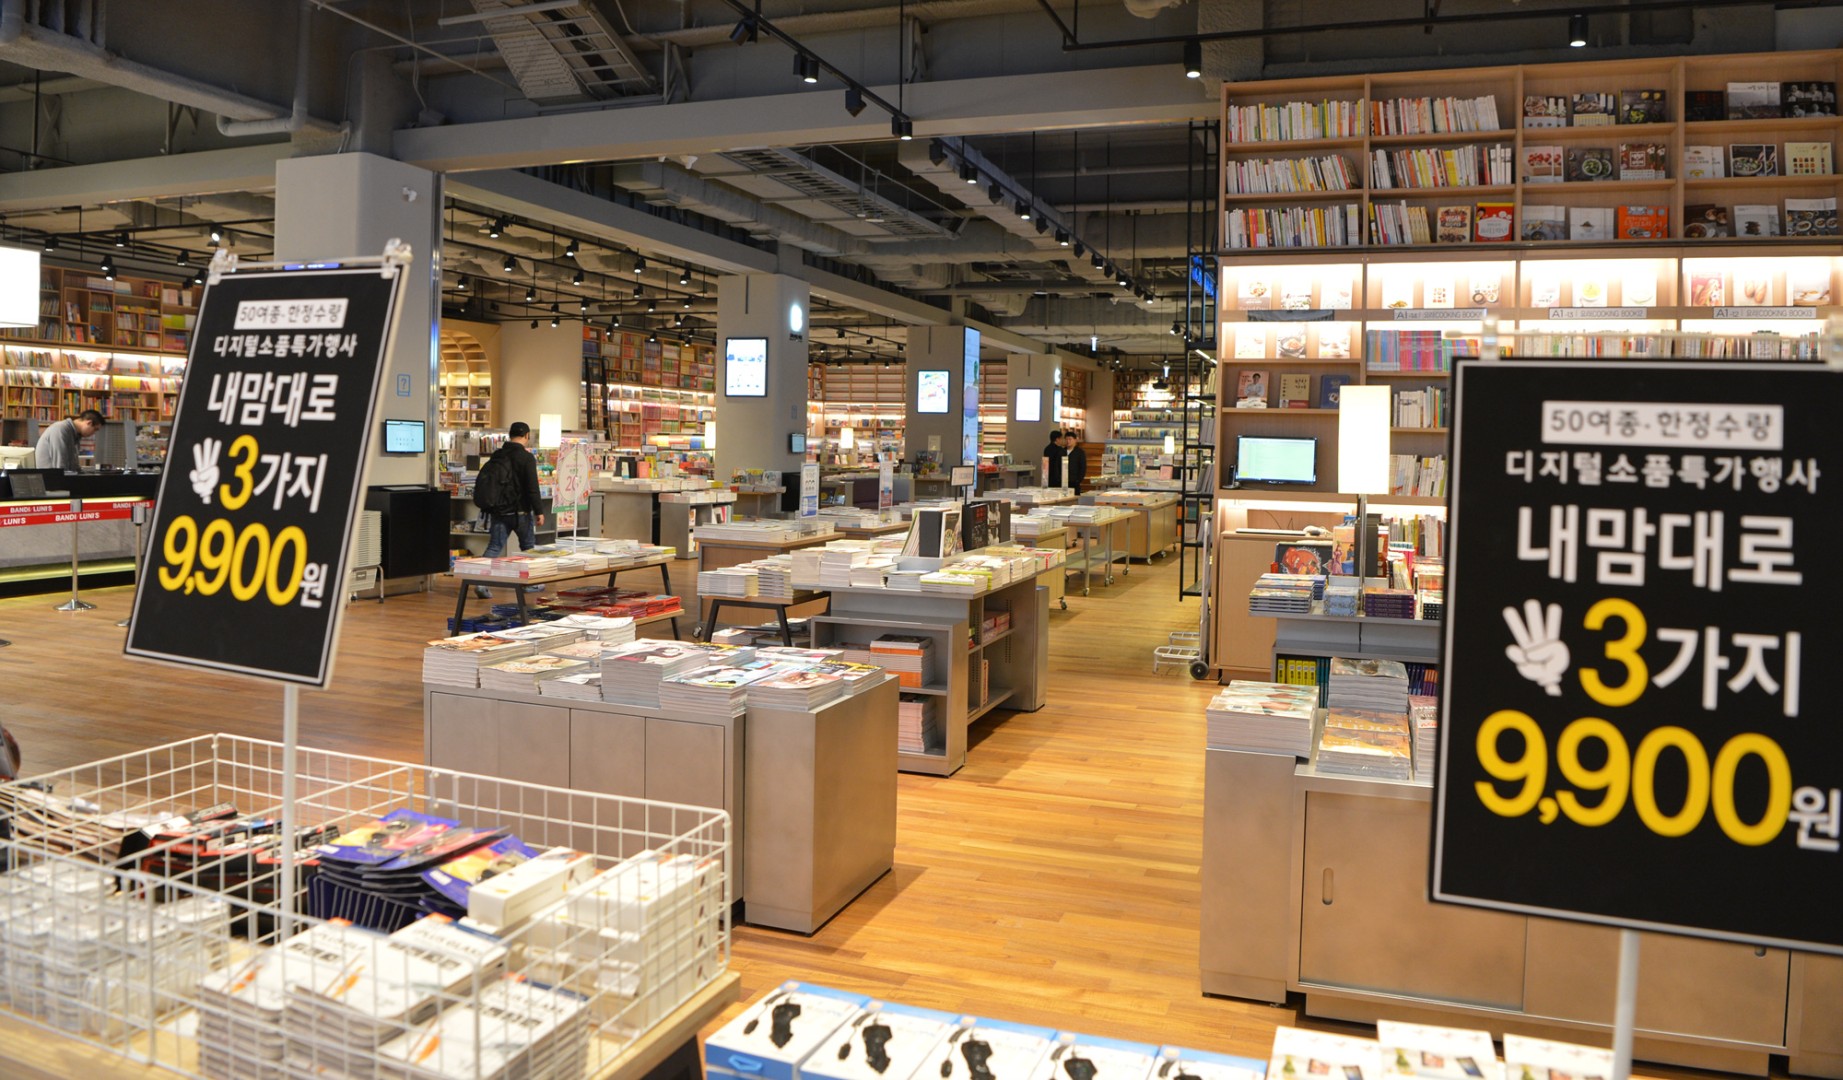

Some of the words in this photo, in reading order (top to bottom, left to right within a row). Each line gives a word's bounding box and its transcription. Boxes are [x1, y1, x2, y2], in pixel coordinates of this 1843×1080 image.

[213, 333, 358, 358] 디지털소품특가행사
[207, 371, 339, 428] 내맘대로
[1505, 450, 1821, 495] 디지털소품특가행사
[1516, 504, 1803, 592] 내맘대로
